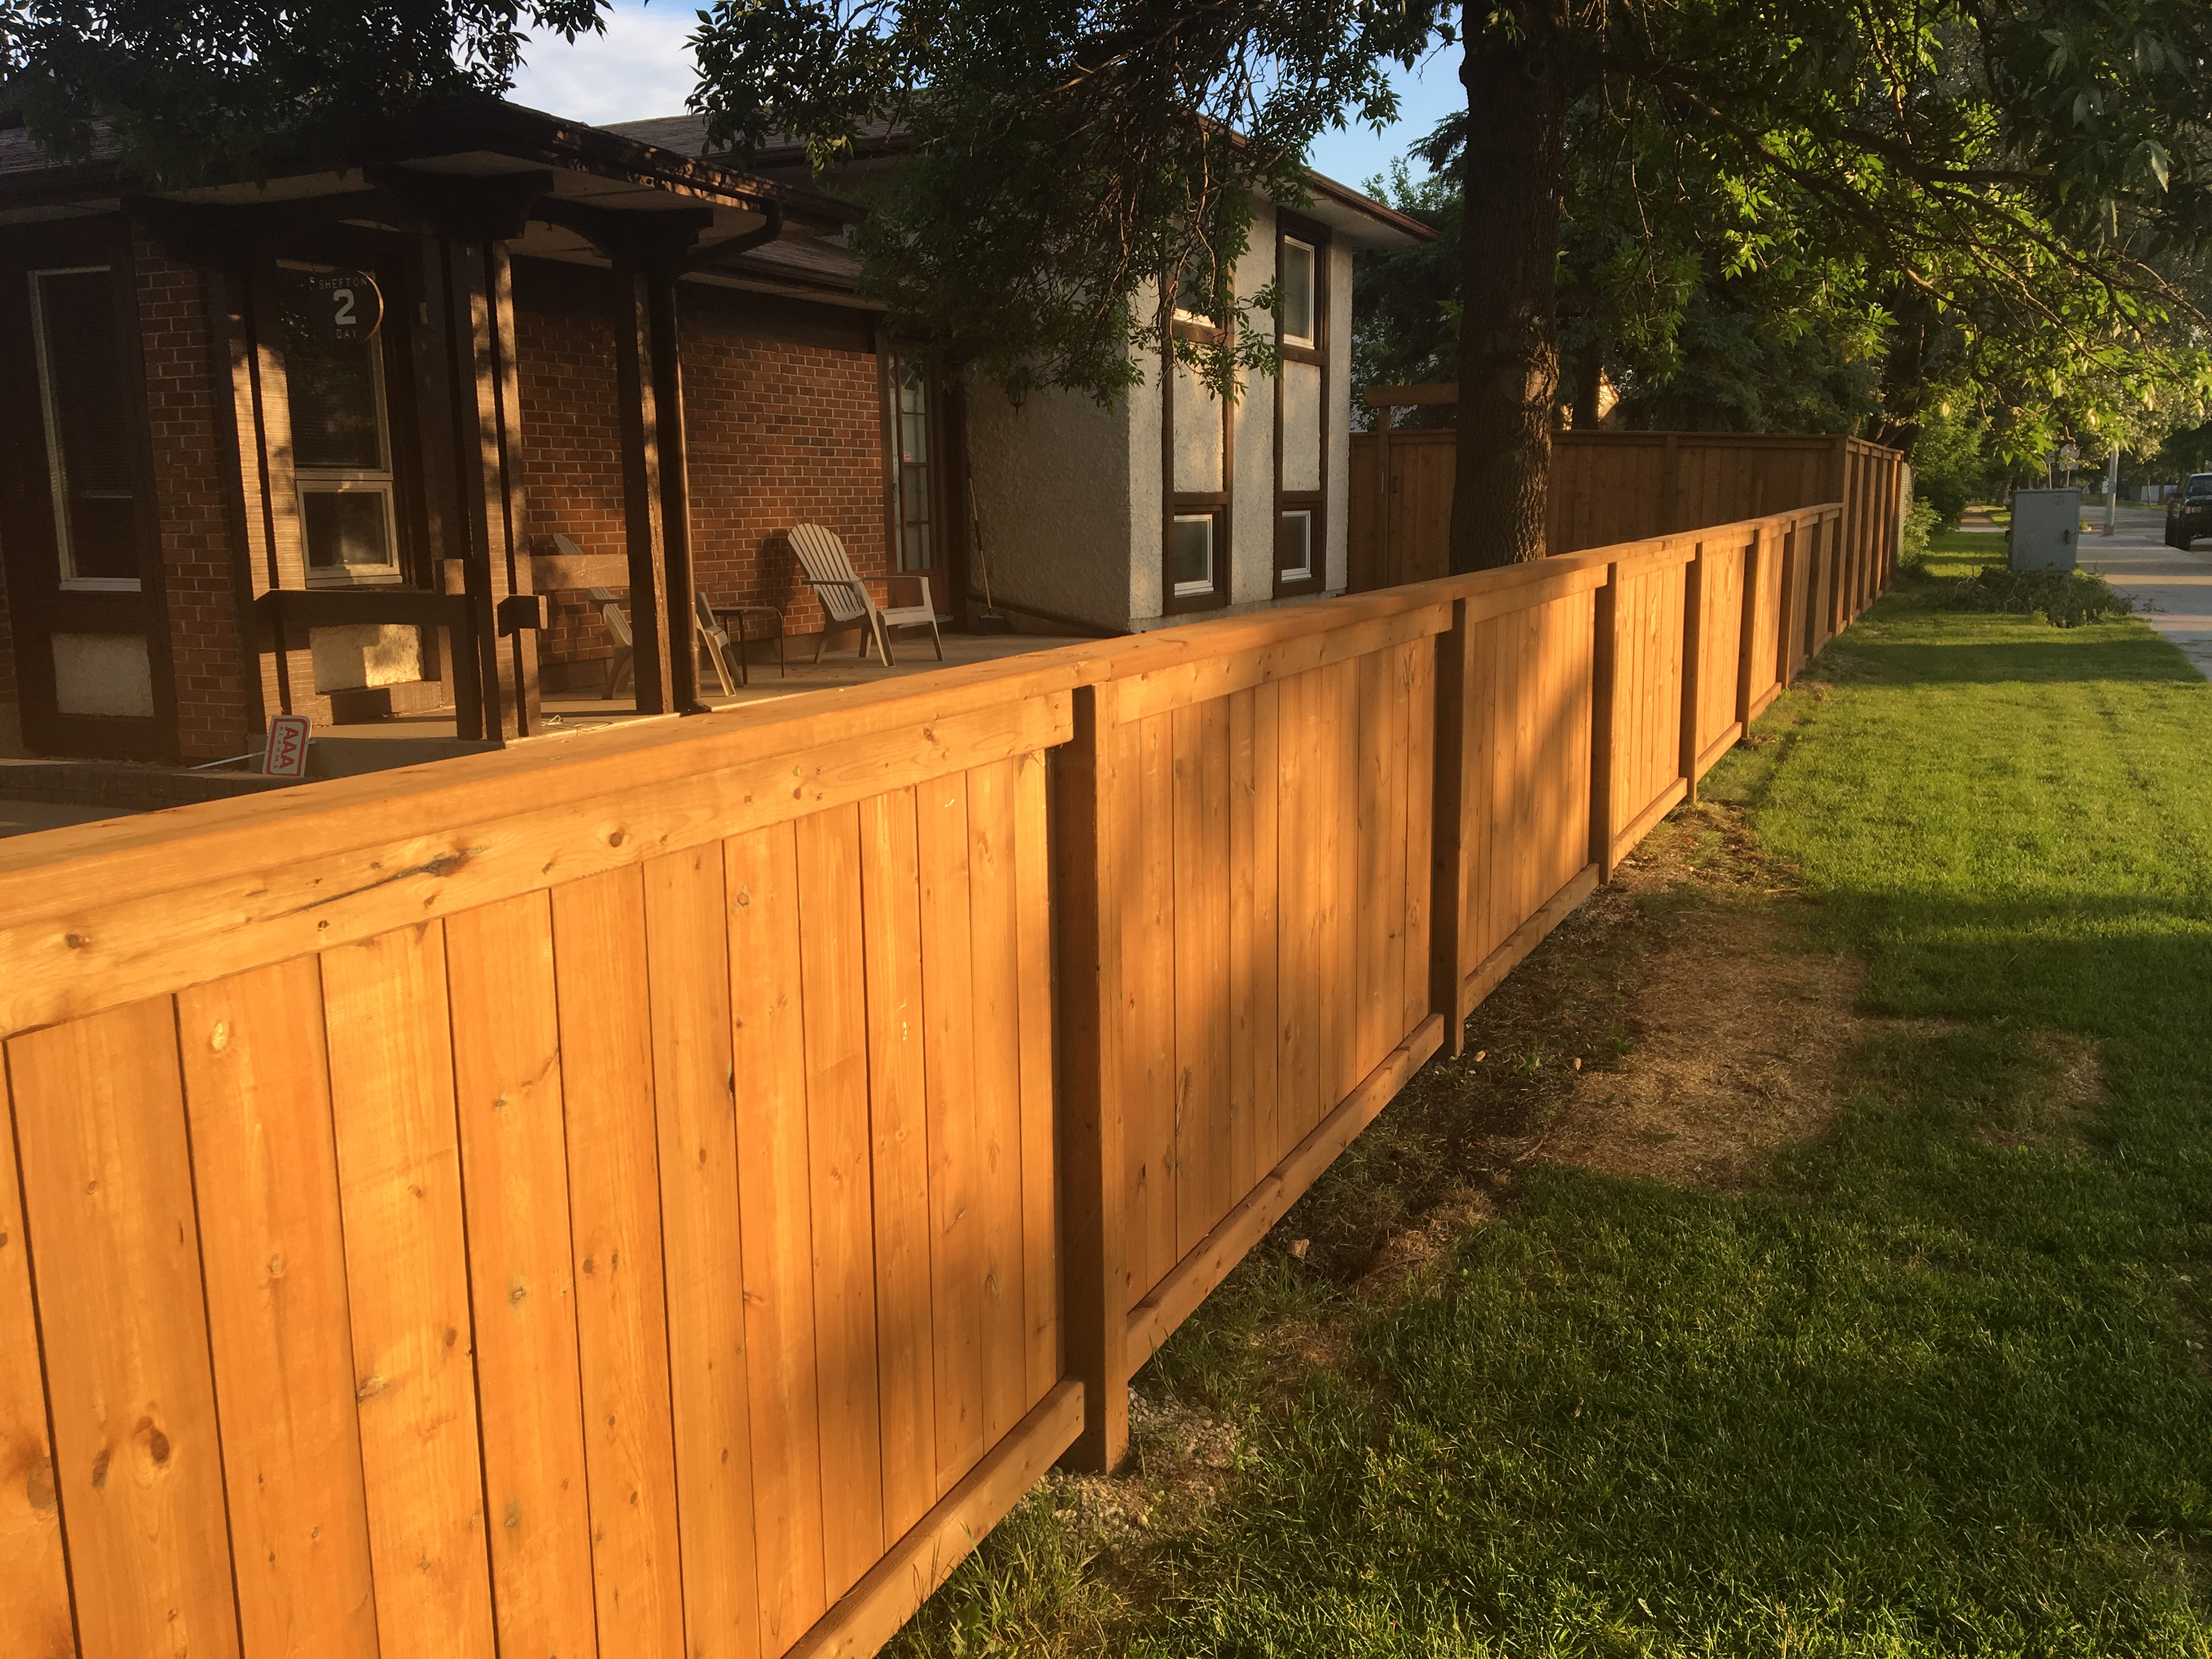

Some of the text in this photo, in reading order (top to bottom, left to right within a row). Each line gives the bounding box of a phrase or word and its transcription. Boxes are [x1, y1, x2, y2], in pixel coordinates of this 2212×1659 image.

[333, 289, 356, 325] 2
[274, 726, 284, 769] ALARMS
[279, 726, 299, 769] AAA
